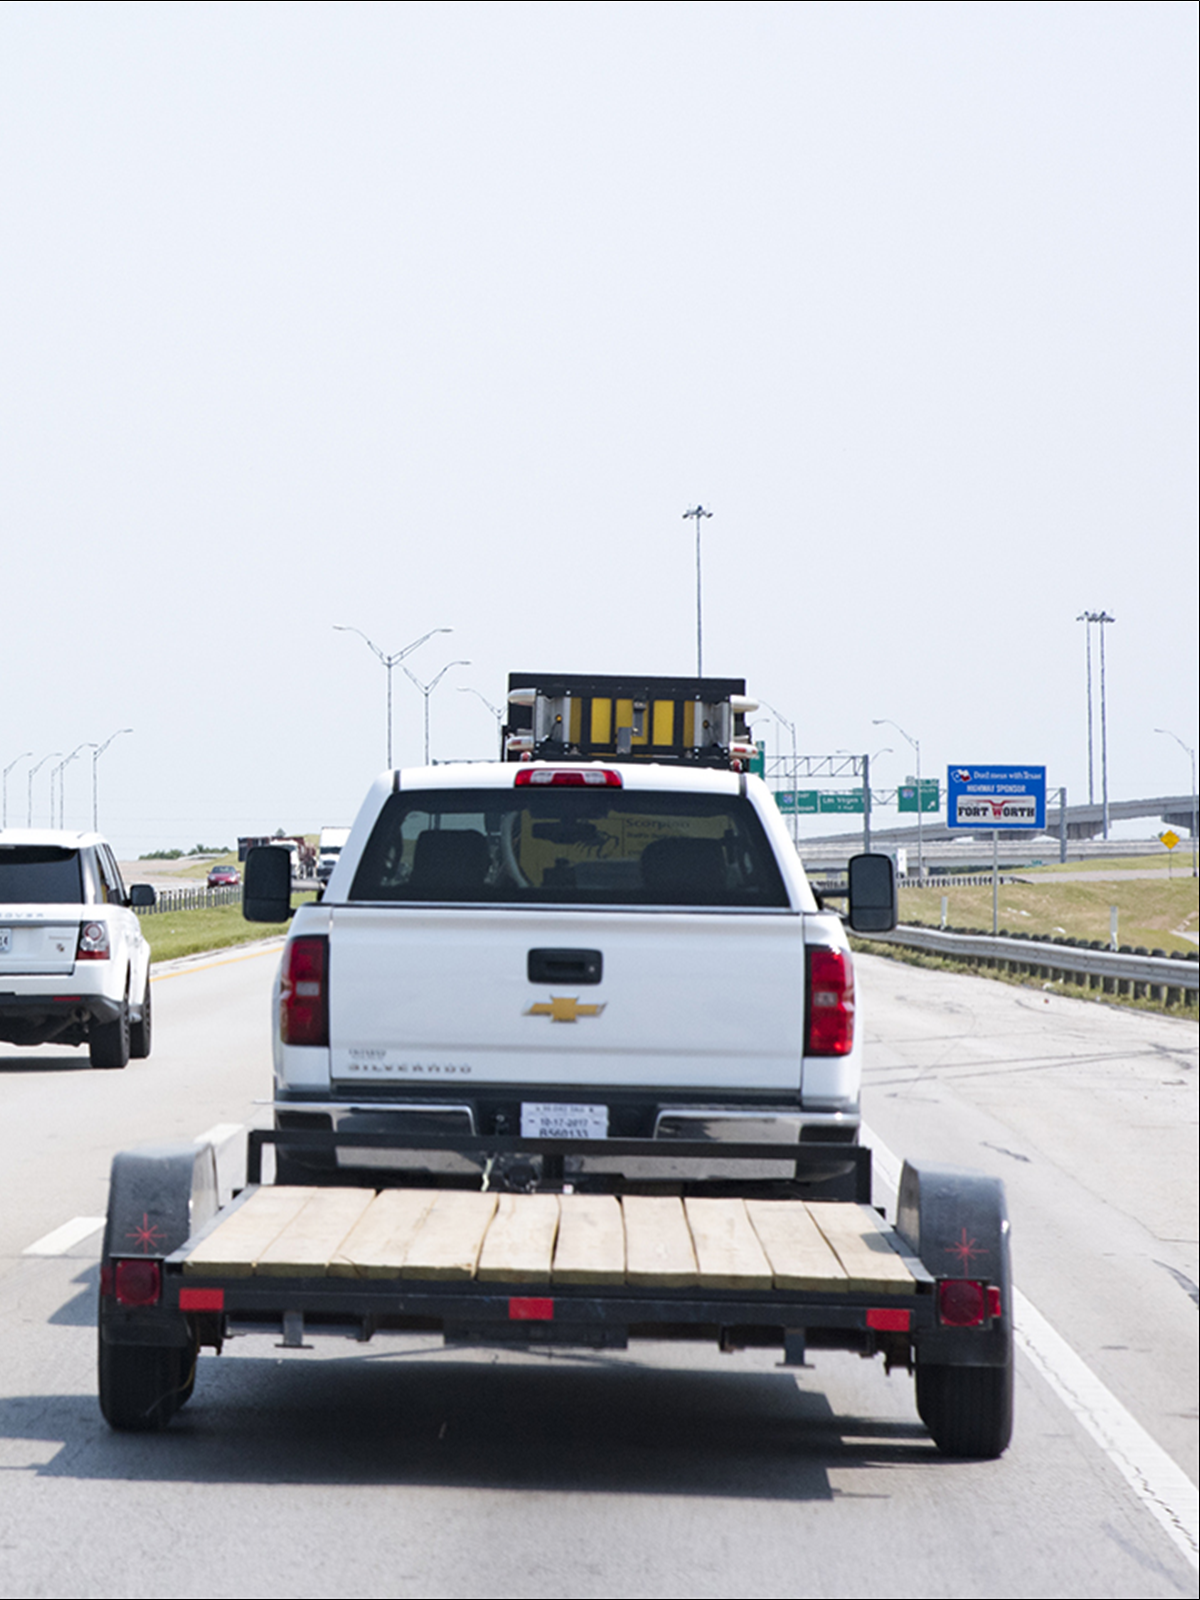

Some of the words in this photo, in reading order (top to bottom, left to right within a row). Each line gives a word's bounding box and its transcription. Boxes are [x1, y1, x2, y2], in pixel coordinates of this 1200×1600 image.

[958, 806, 989, 817] FORT
[991, 803, 1035, 819] WORTH
[347, 1063, 472, 1074] SILVERADO
